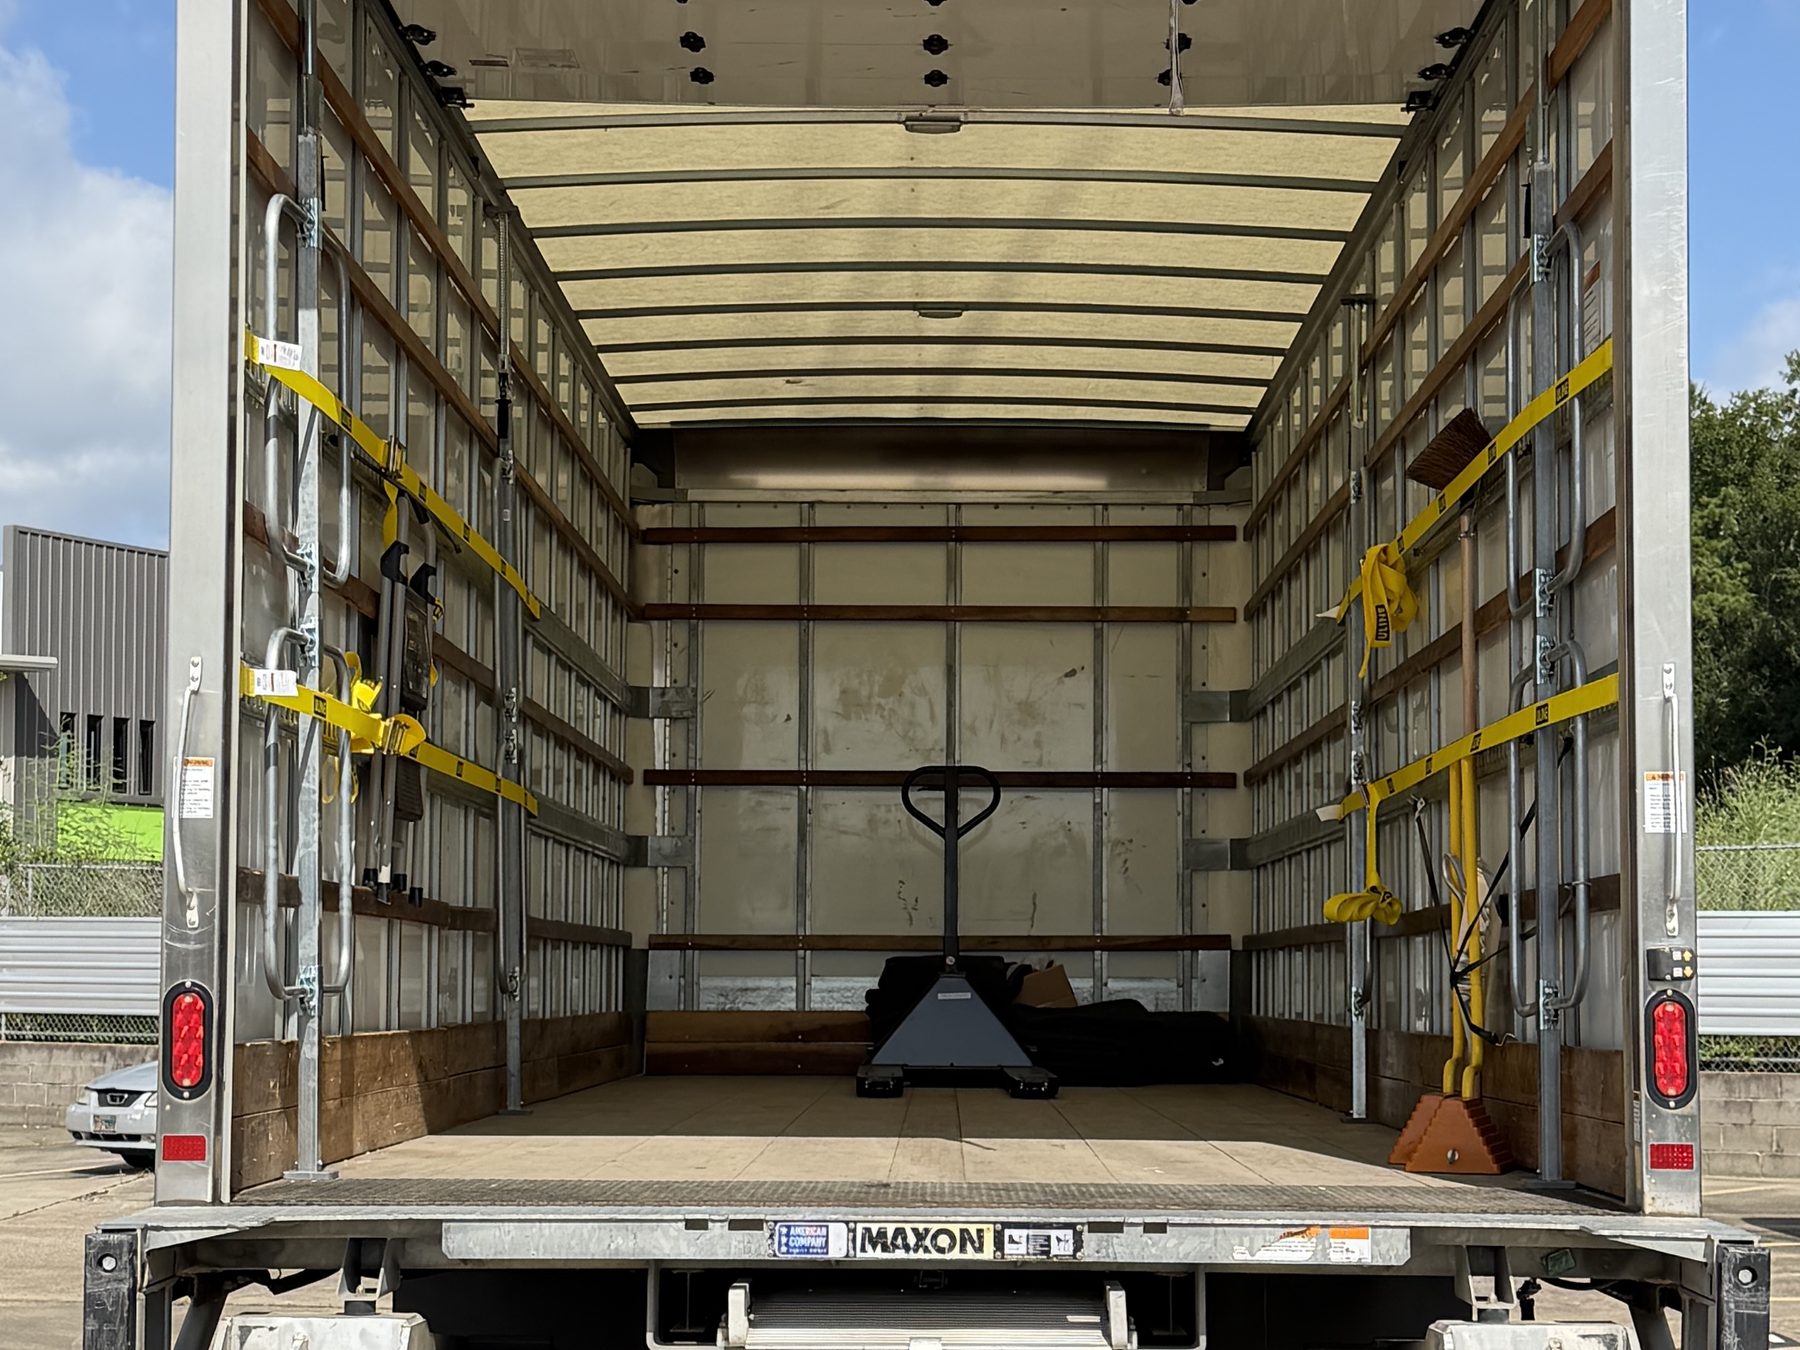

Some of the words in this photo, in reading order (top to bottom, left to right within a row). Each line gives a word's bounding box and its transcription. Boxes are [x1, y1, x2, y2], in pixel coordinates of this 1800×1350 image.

[1377, 605, 1389, 639] ULINE
[790, 1226, 827, 1236] AMERICAN
[789, 1237, 826, 1247] COMPANY
[860, 1227, 985, 1255] MAXON
